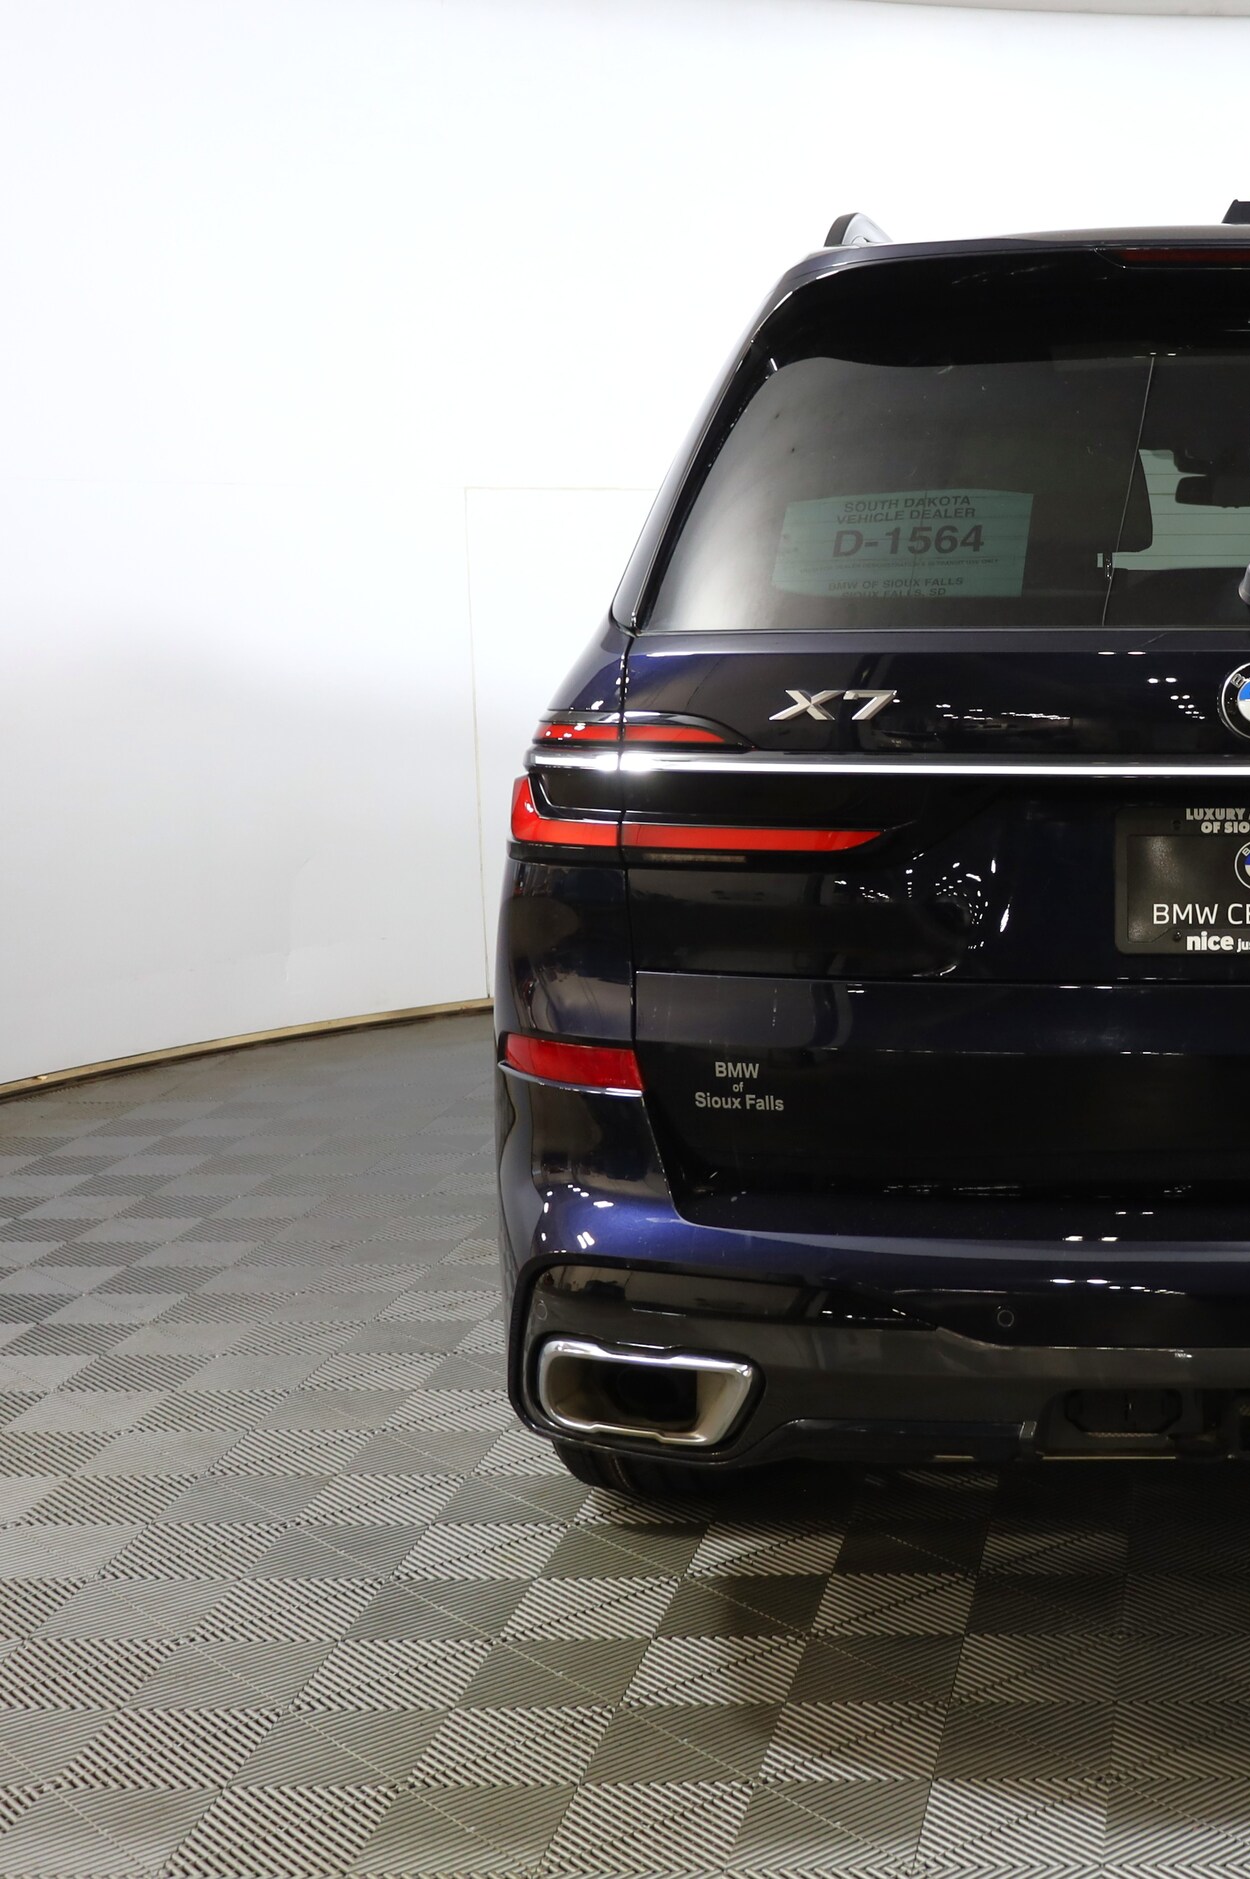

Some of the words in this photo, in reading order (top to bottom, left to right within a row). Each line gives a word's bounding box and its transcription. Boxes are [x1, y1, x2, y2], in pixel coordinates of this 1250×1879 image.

[844, 499, 900, 512] SOUTH
[904, 495, 971, 508] DAKOTA
[837, 510, 905, 524] VEHICLE
[909, 508, 976, 520] DEALER
[832, 524, 985, 557] D-1564
[862, 579, 878, 589] OF
[883, 578, 921, 588] SIOUX
[924, 577, 964, 587] FALLS
[768, 689, 898, 721] X7
[1185, 807, 1247, 820] LUXURY
[1200, 821, 1222, 834] OF
[1152, 903, 1219, 925] BMW
[1186, 931, 1234, 951] nice
[714, 1061, 760, 1079] BMW
[732, 1081, 744, 1092] of
[694, 1091, 742, 1109] Sioux
[745, 1094, 785, 1111] Falls
